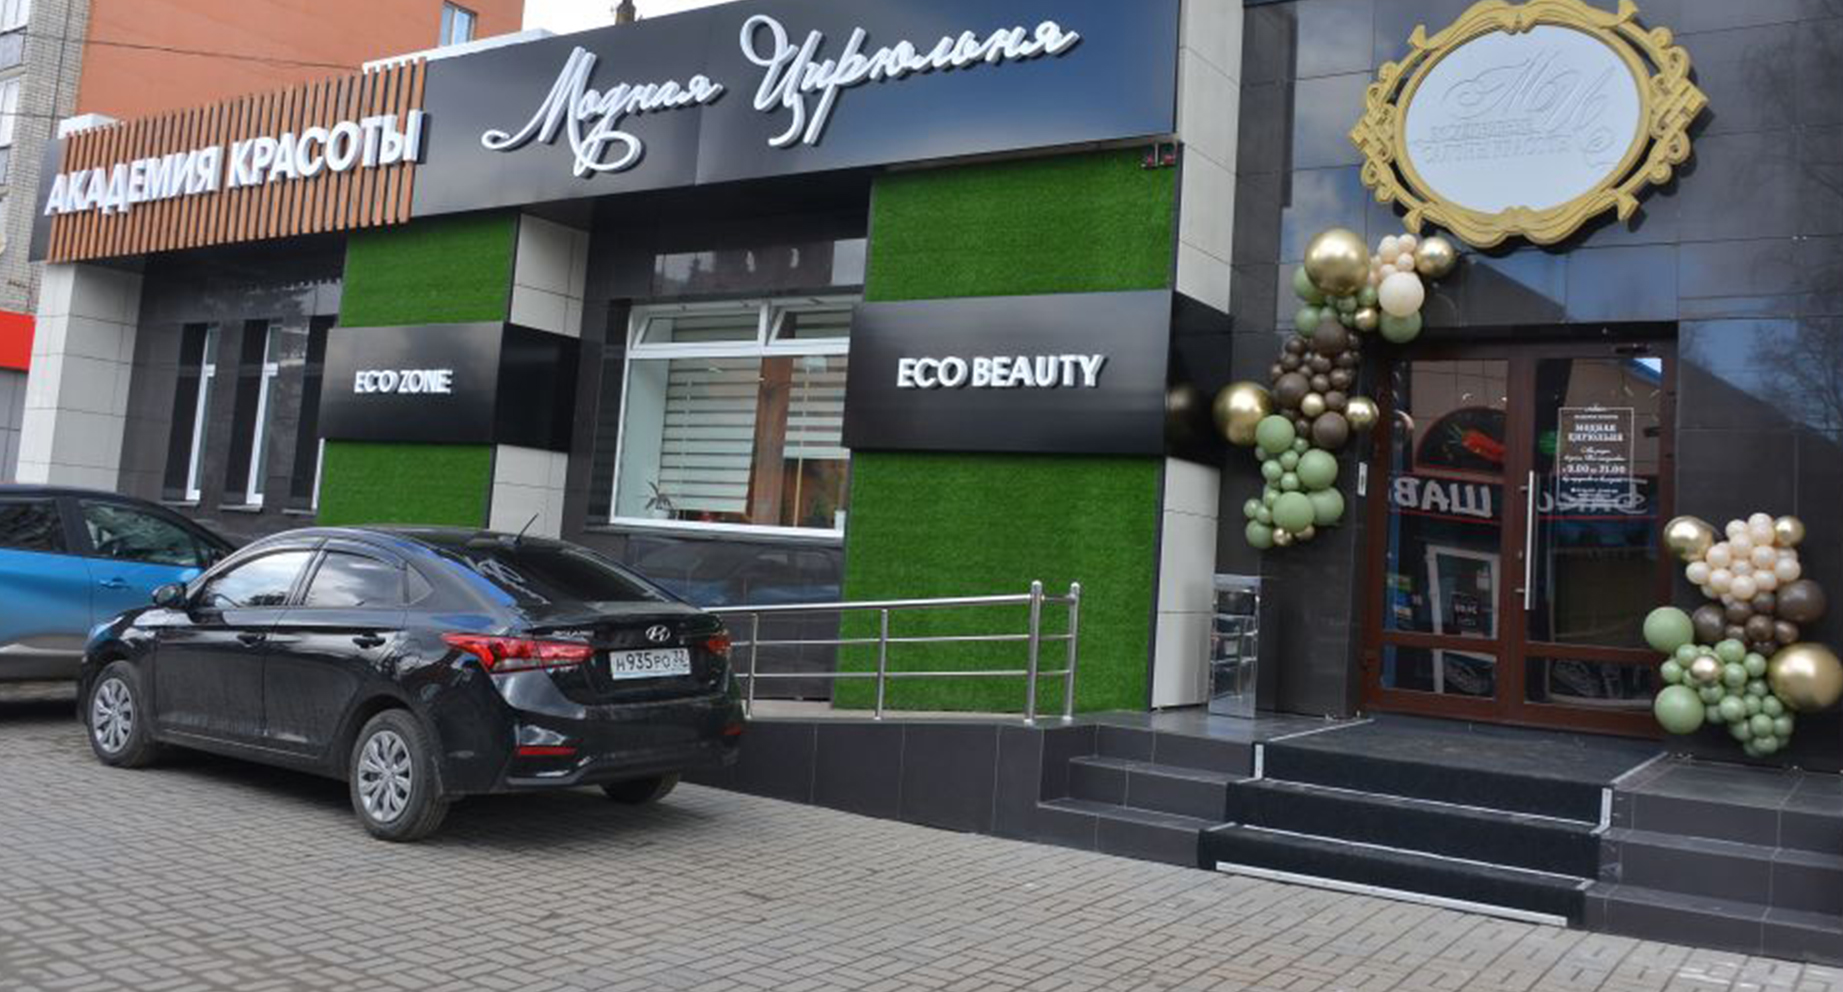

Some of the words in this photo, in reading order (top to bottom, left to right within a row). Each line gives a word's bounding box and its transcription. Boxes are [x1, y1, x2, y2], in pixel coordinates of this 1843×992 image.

[482, 46, 724, 177] Модная
[44, 146, 222, 217] АКАДЕМИЯ
[228, 109, 424, 189] КРАСОТЫ
[354, 369, 399, 393] ECO
[398, 369, 453, 393] ZONE
[897, 356, 969, 388] ECO
[971, 354, 1105, 387] BEAUTY
